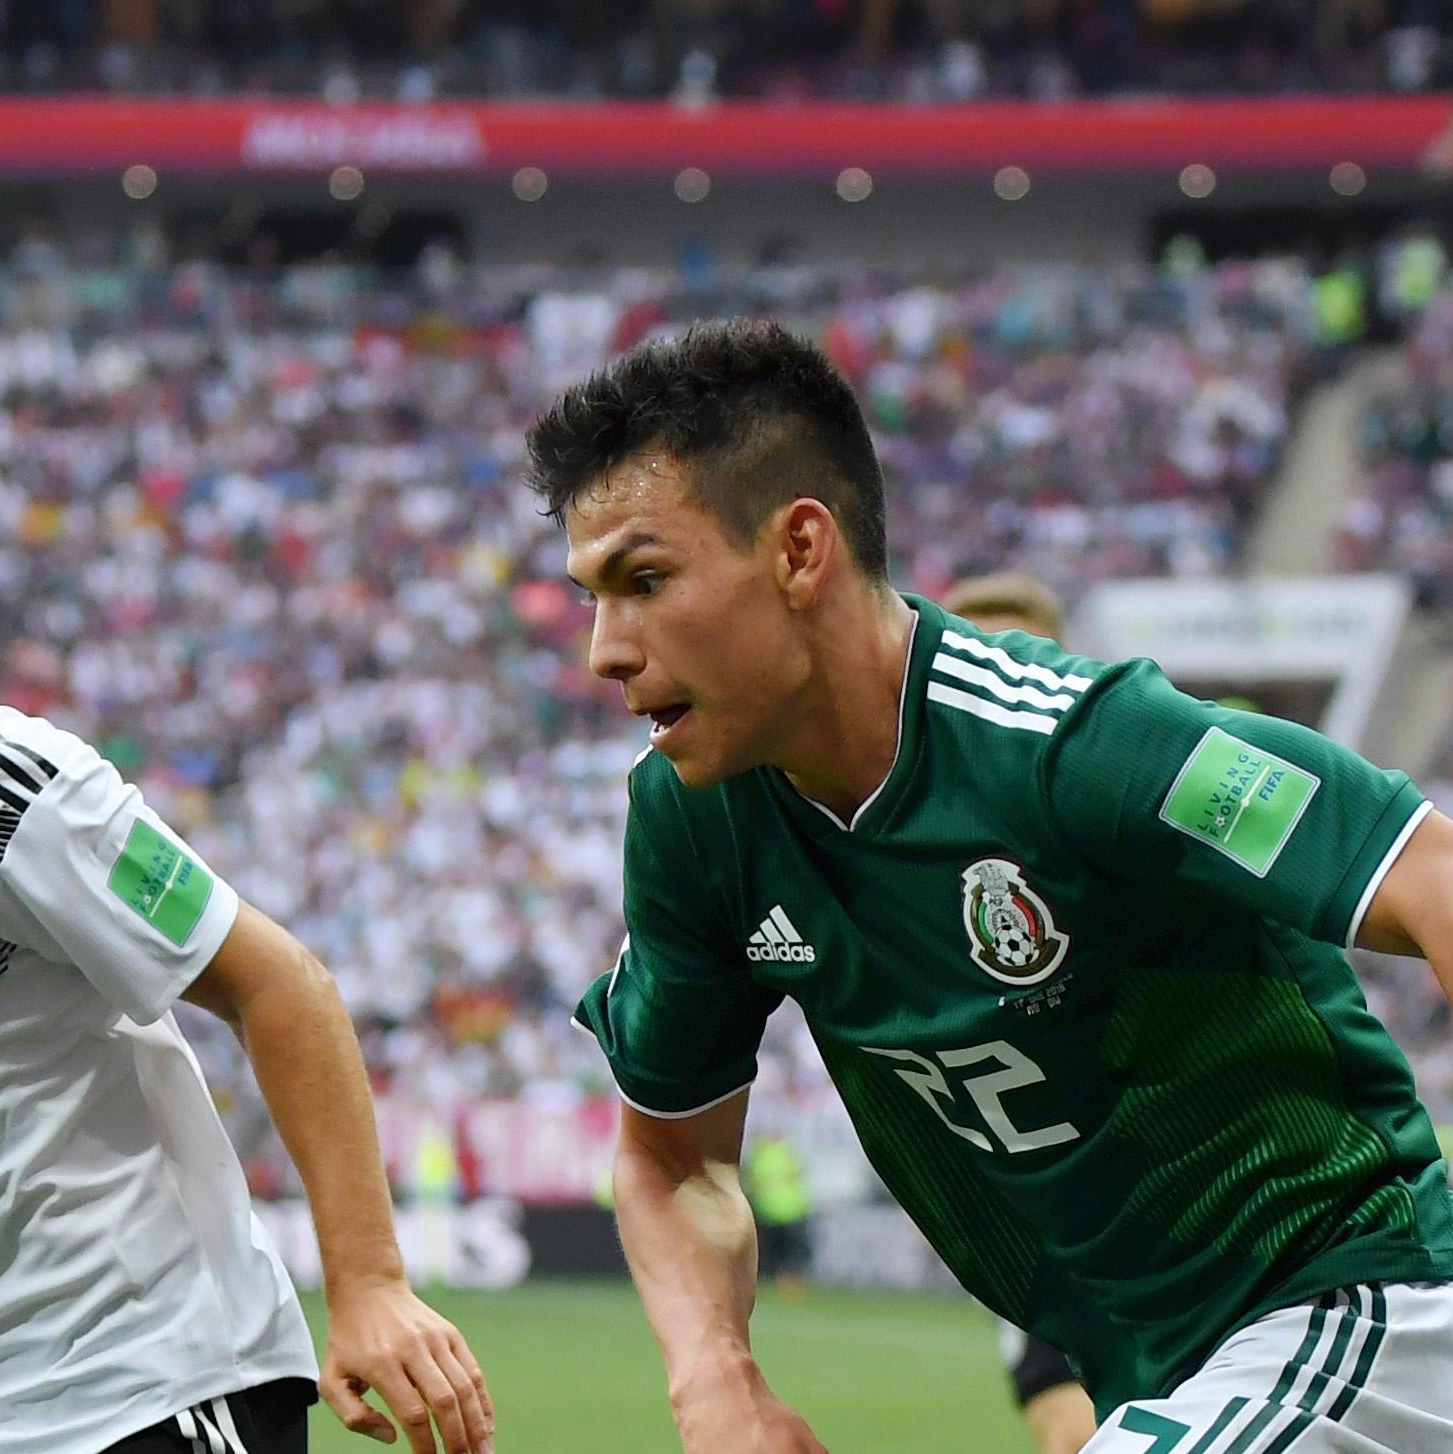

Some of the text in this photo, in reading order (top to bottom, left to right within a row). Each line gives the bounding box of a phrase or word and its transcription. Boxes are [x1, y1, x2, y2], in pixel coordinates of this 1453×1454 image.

[1197, 752, 1250, 832] LIVING
[1257, 770, 1285, 802] FIFA
[745, 941, 816, 963] adidas
[858, 1039, 1083, 1155] 22
